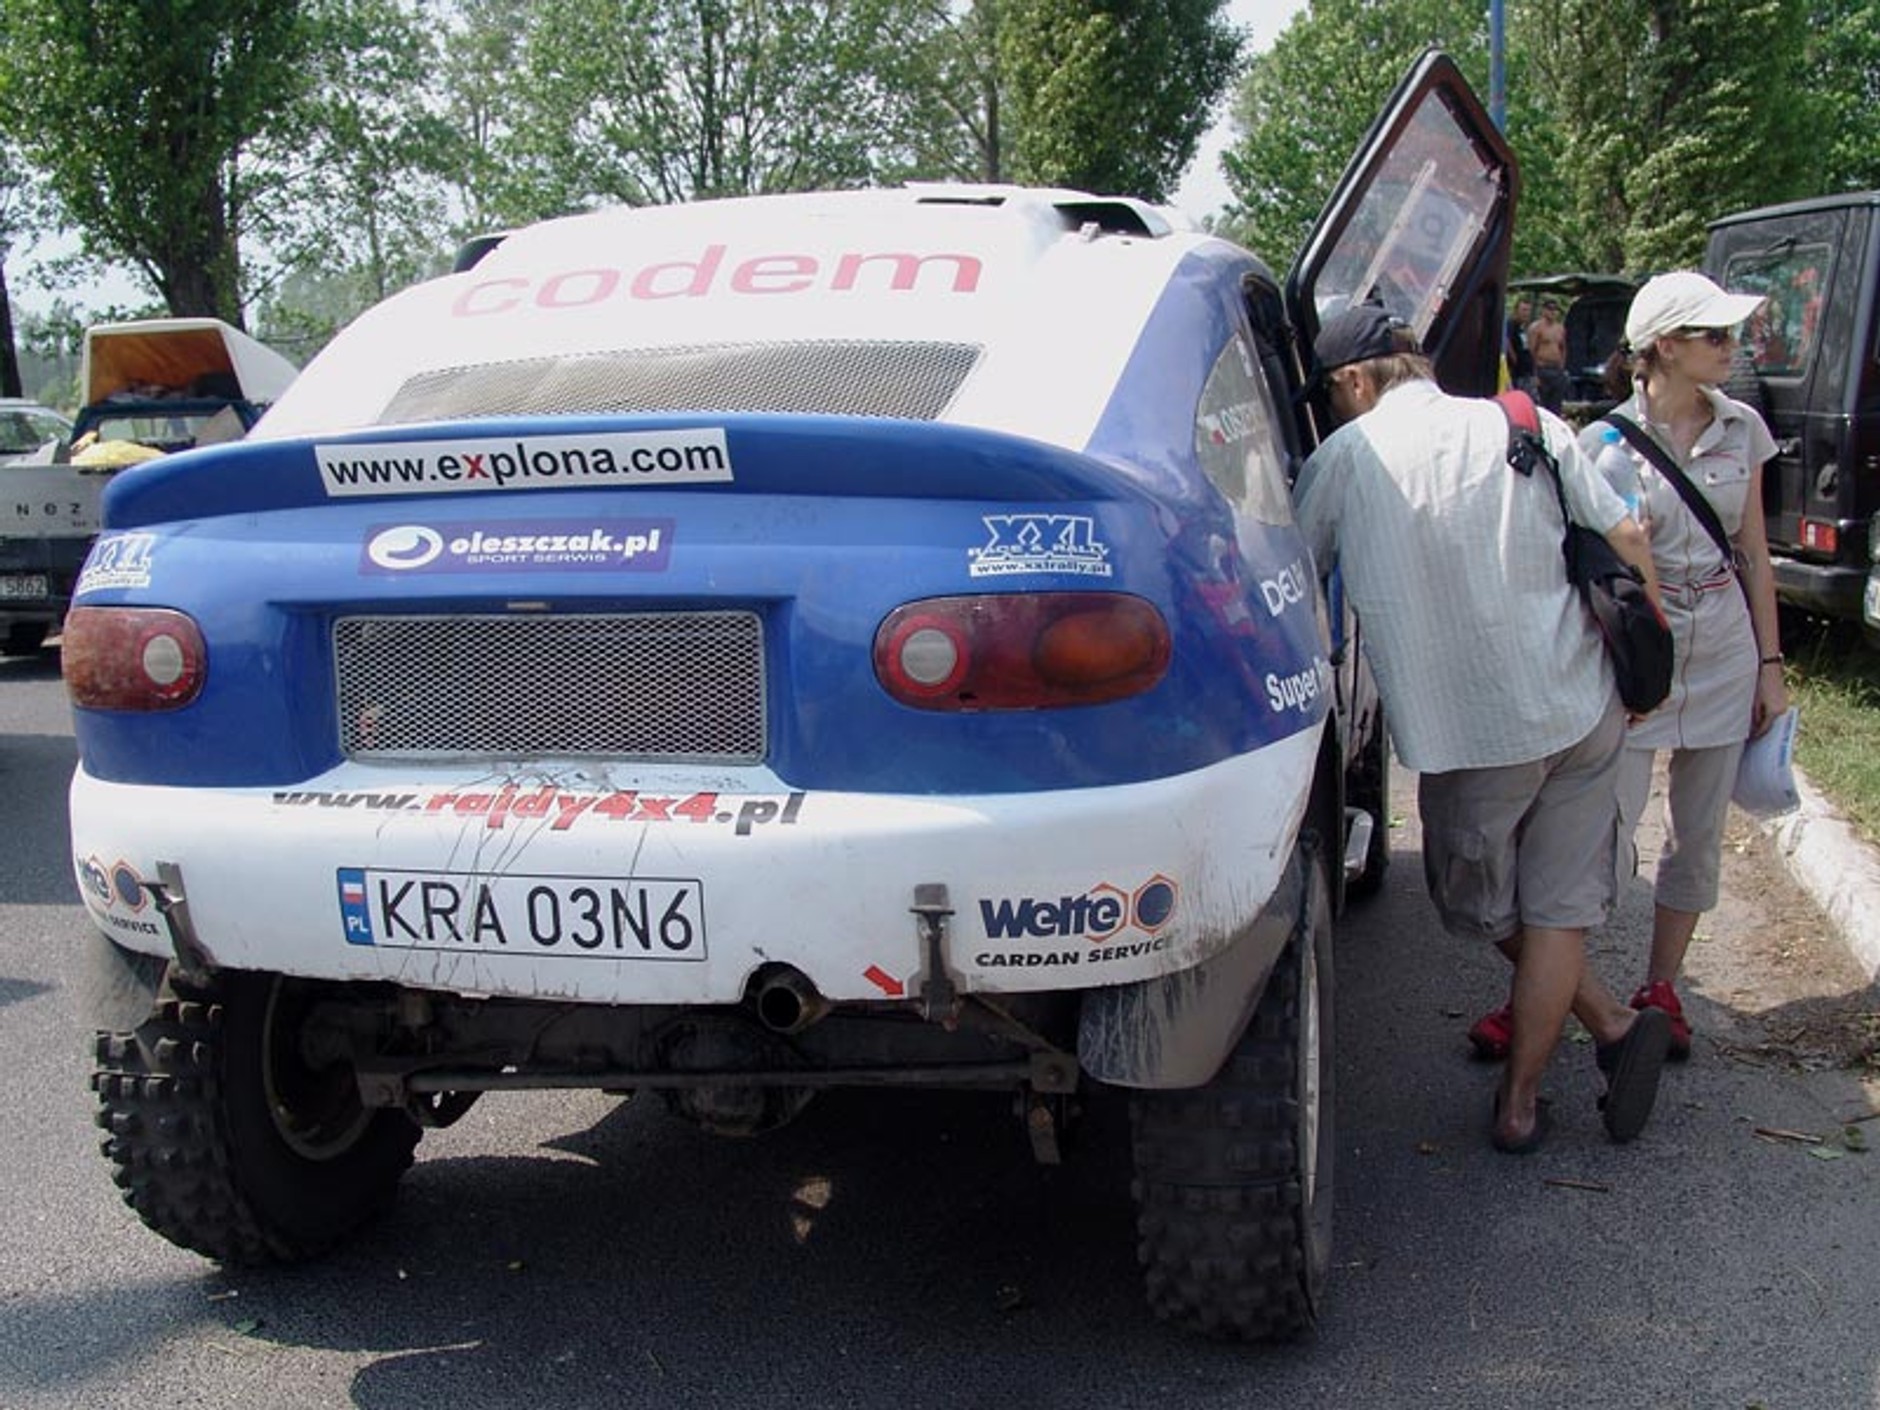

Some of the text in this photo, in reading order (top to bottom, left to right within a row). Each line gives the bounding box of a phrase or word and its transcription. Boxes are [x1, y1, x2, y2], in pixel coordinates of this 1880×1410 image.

[451, 244, 984, 318] codem
[327, 443, 725, 485] www.explona.com
[450, 528, 660, 558] oleszczak.pl
[982, 514, 1104, 560] XXL
[467, 553, 607, 564] SPORT SERWIS
[5, 577, 44, 594] 5862
[273, 783, 807, 836] www.rajdy4x4.pl
[348, 917, 370, 933] PL
[379, 879, 693, 951] KRA 03N6
[976, 951, 1079, 967] CARDAN
